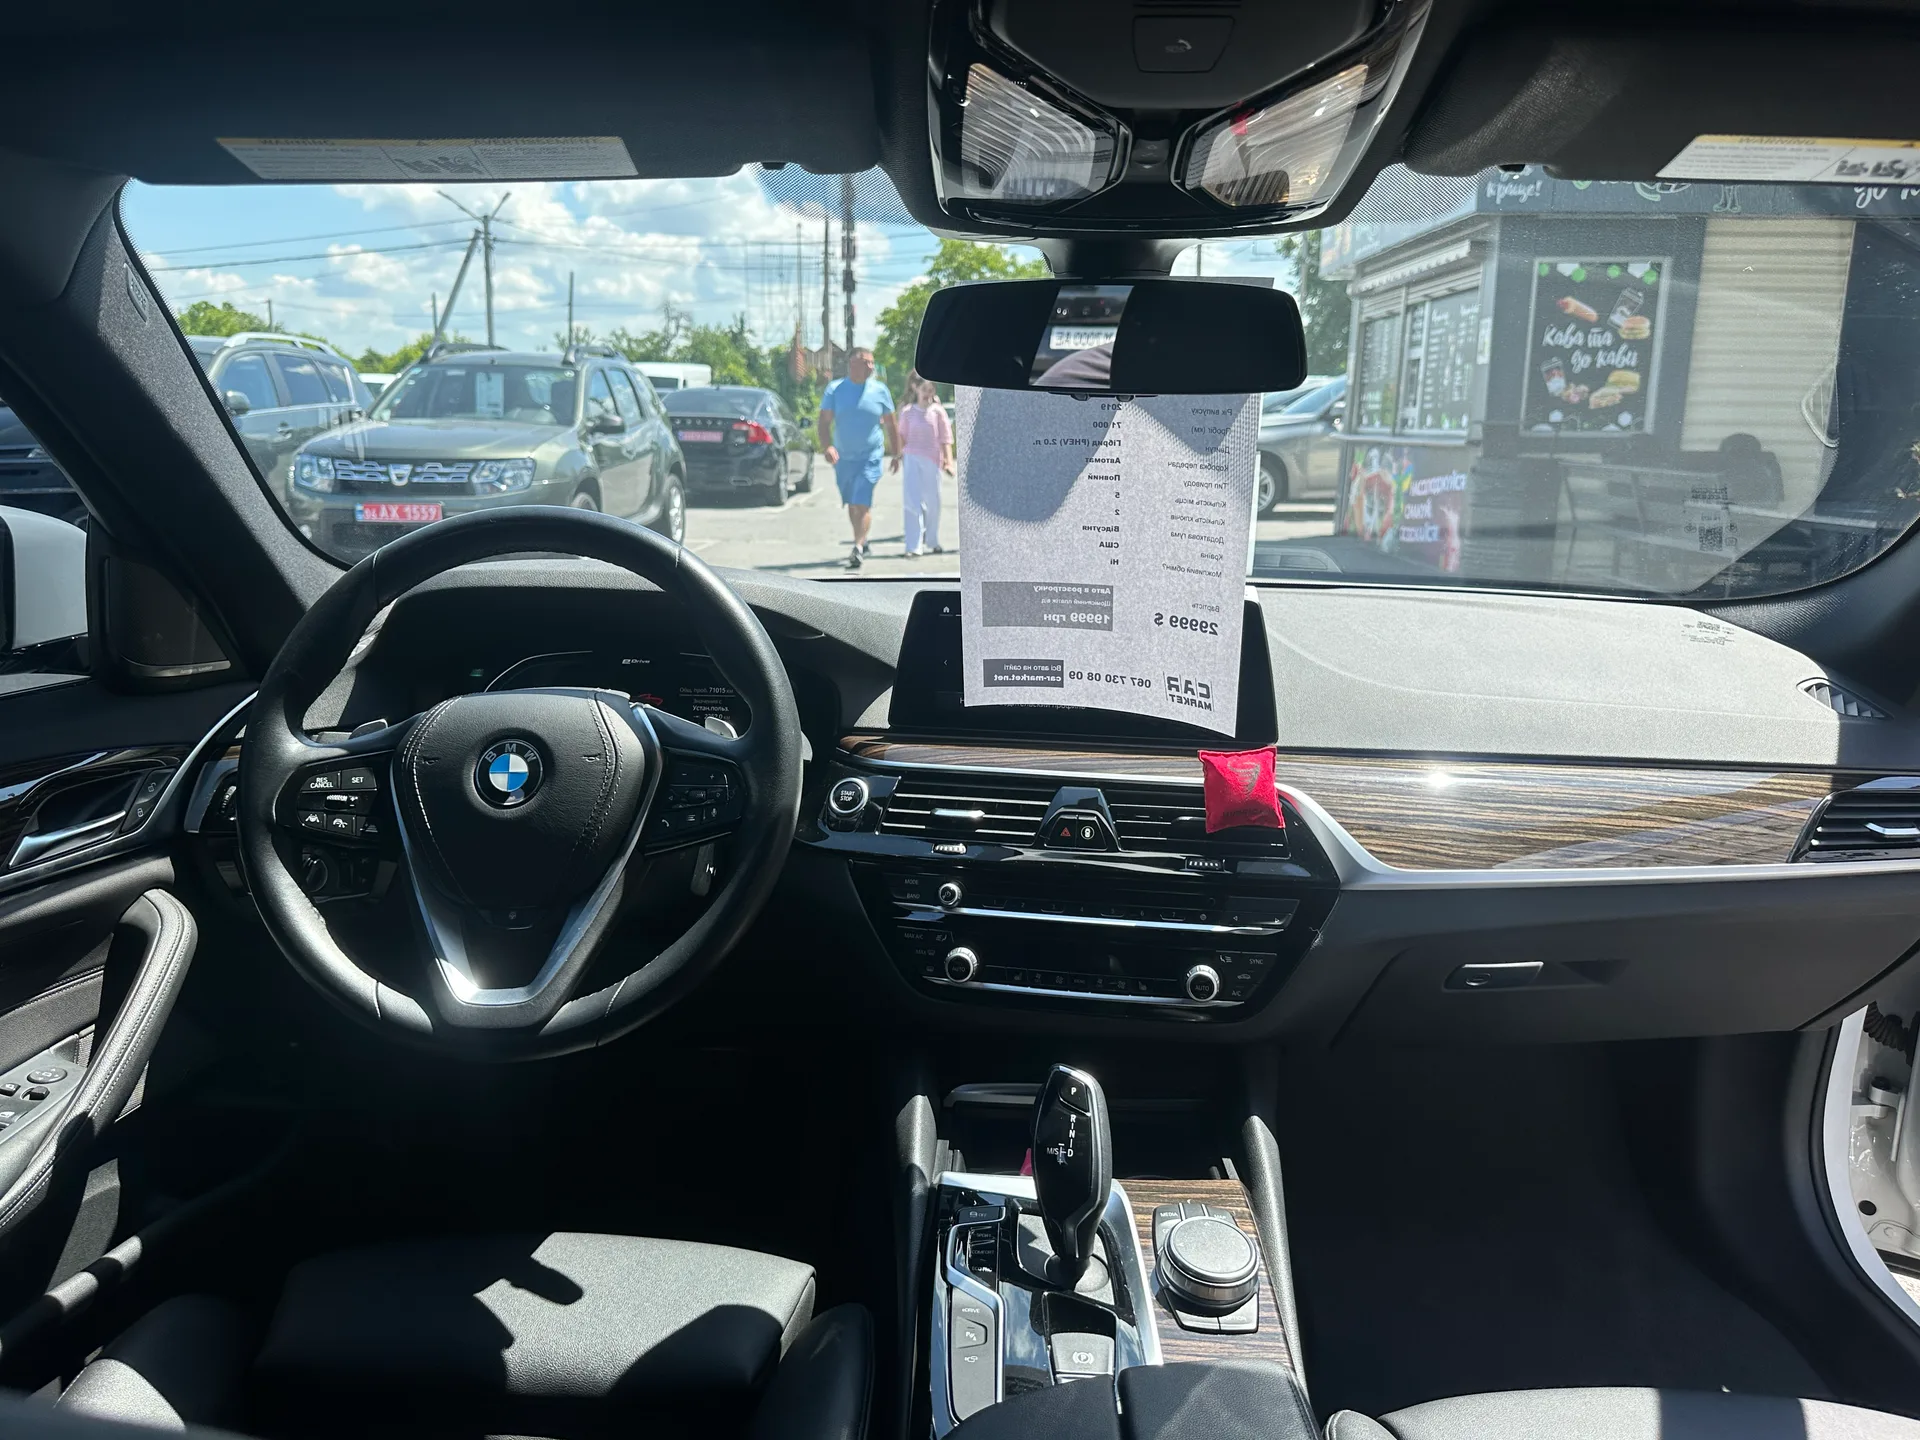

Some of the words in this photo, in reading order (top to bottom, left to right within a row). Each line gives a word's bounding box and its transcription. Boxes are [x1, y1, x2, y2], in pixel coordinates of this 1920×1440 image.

[1739, 137, 1816, 145] WARNING
[1542, 322, 1585, 349] Кава
[1570, 349, 1592, 374] до
[1595, 343, 1638, 368] кави
[709, 687, 726, 697] 71015
[485, 743, 537, 763] BMW
[351, 776, 364, 784] SET
[1195, 984, 1209, 992] AUTO
[1071, 1087, 1077, 1095] P
[1070, 1114, 1077, 1123] R
[1069, 1130, 1076, 1139] N
[1047, 1147, 1059, 1155] M/S
[1067, 1148, 1074, 1157] D
